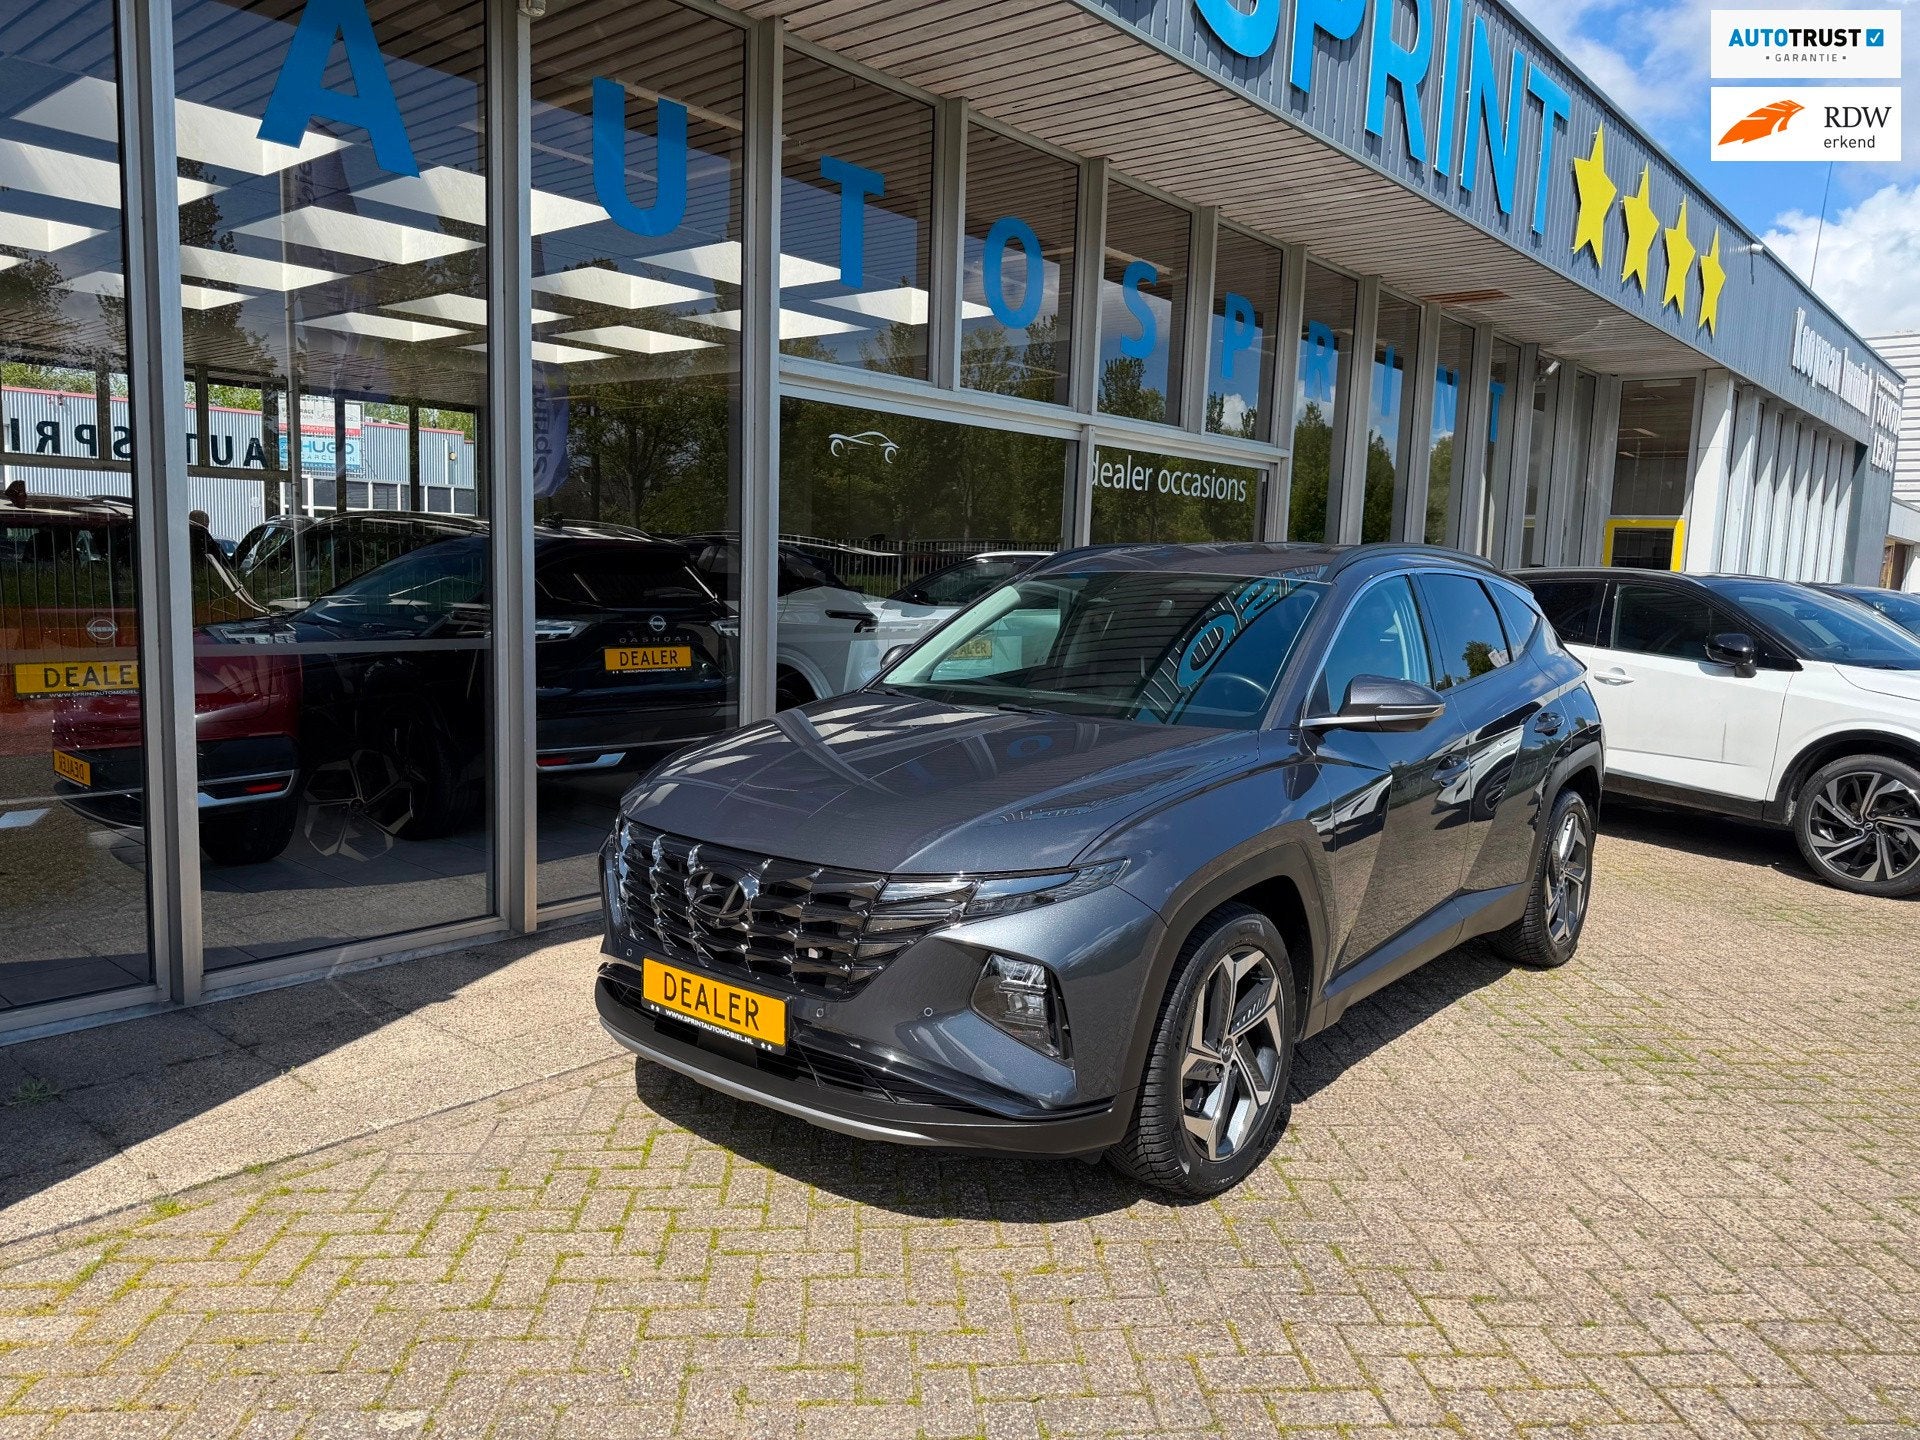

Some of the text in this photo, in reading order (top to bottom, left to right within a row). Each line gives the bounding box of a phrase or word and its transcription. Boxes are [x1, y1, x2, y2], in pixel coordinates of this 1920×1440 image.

[1197, 0, 1571, 235] RINT
[1092, 450, 1246, 502] dealer occasions
[43, 664, 134, 689] DEALE
[619, 649, 679, 667] DEALER
[663, 971, 760, 1032] DEALER
[665, 1009, 754, 1045] WWW.SPRINTAUTOMOBIEL.NL
